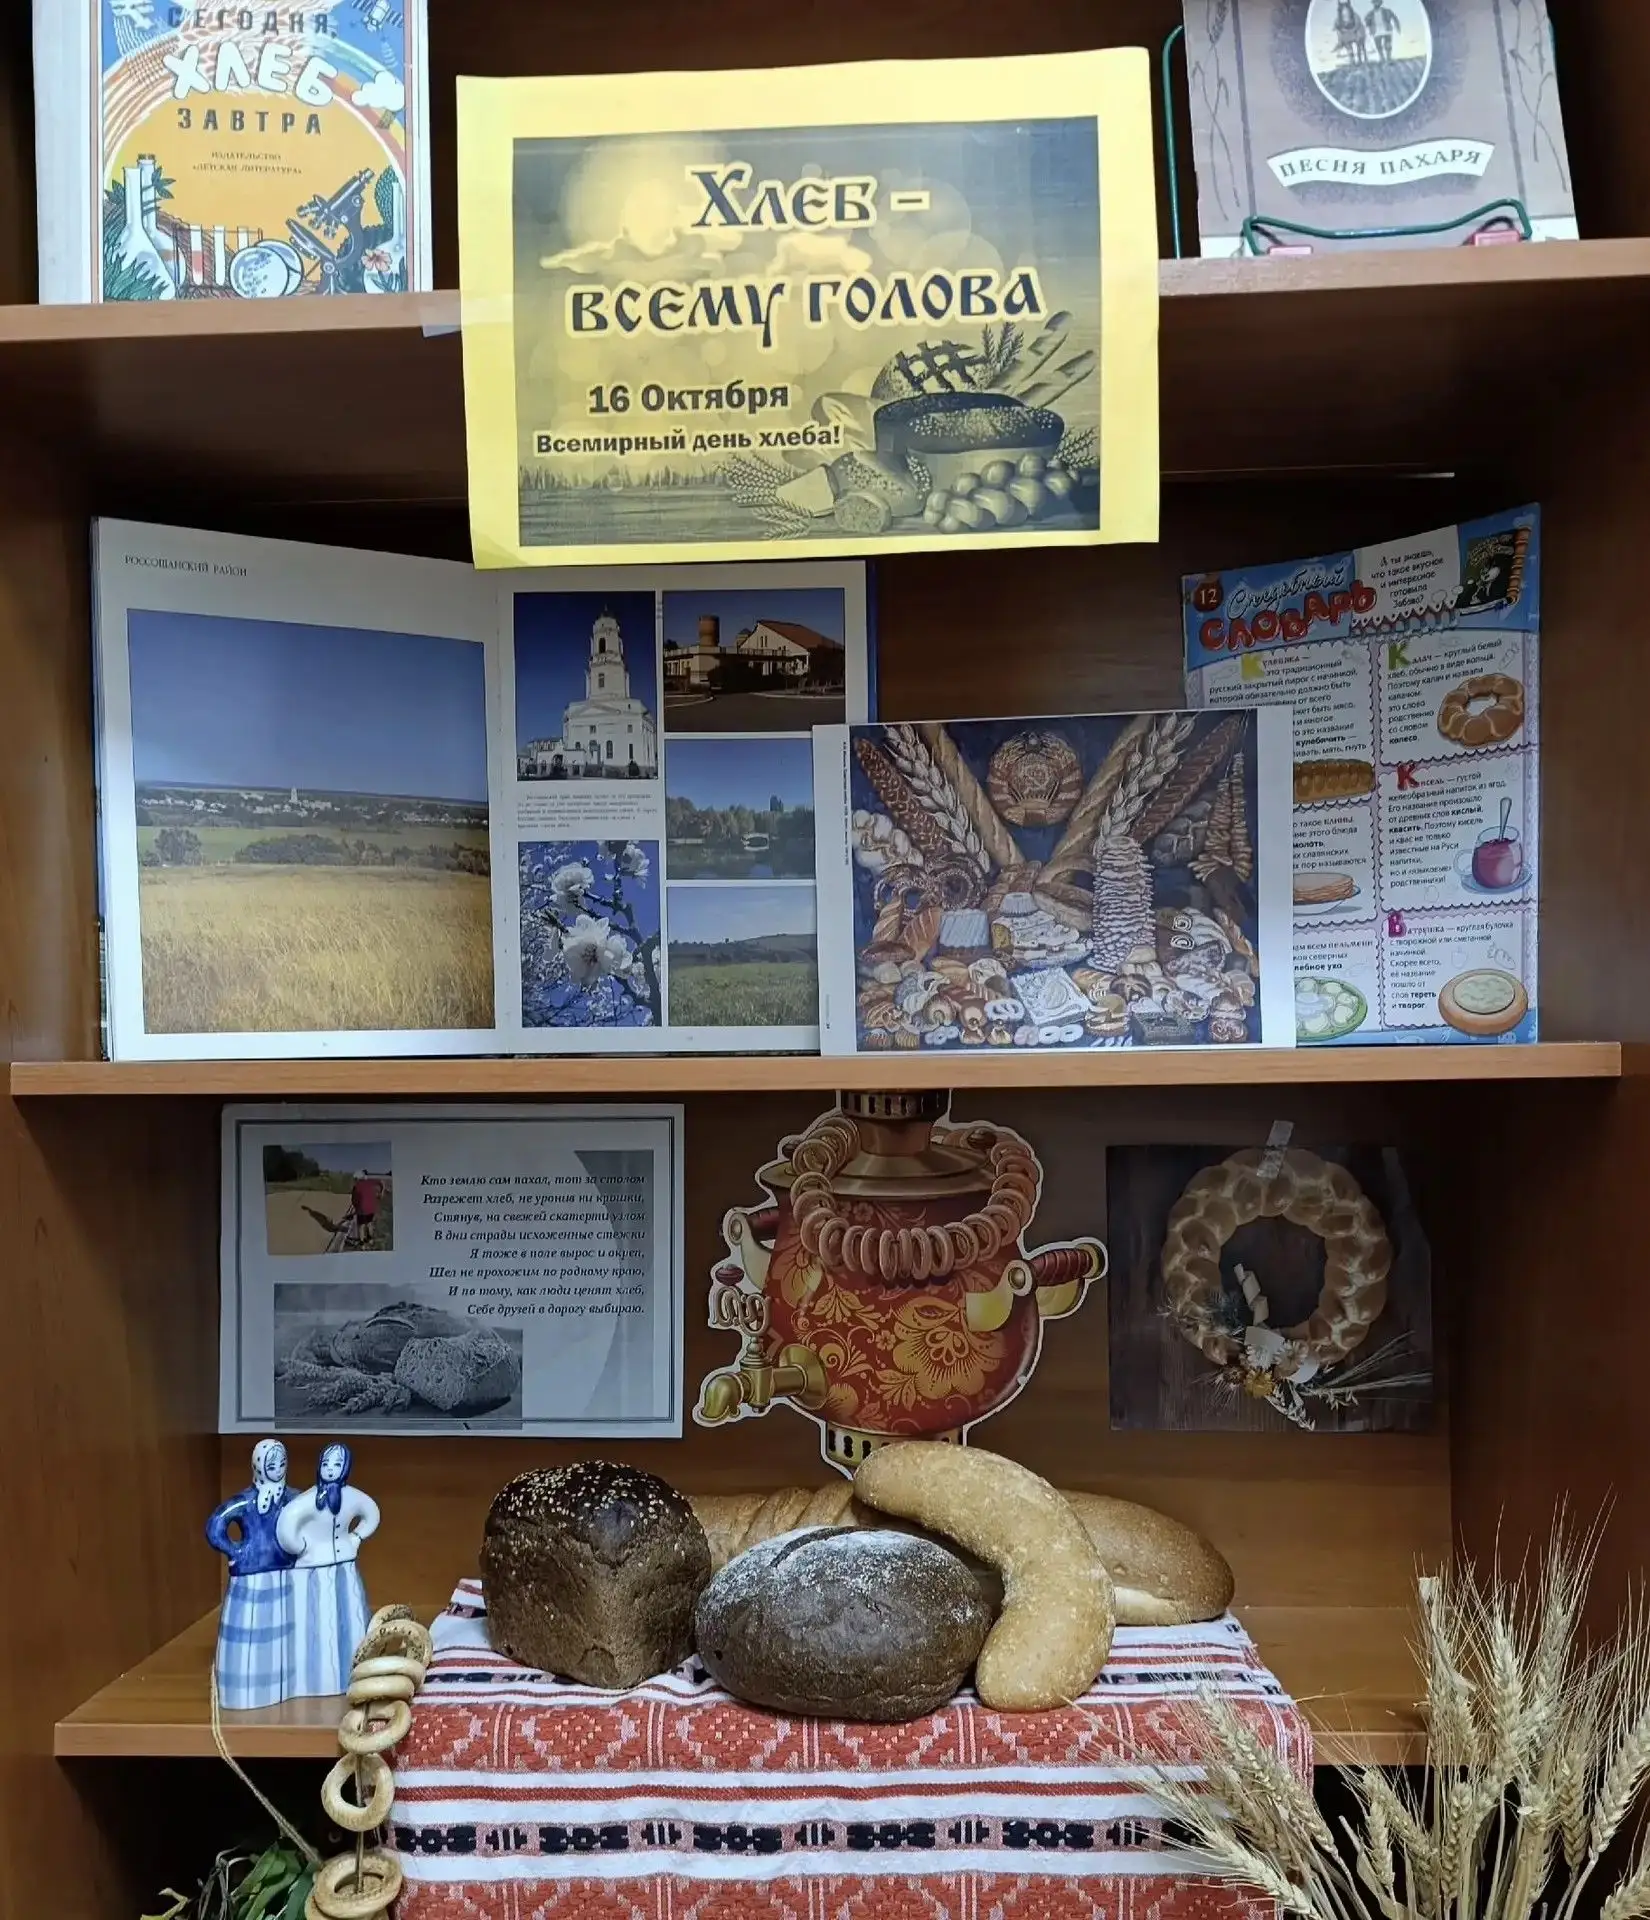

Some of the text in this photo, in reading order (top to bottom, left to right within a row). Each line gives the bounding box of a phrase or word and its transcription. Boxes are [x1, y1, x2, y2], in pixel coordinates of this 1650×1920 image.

[163, 40, 339, 107] ХЛЕБ
[177, 107, 322, 136] ЗАВТРА
[1279, 148, 1483, 178] ПЕСНЯ ПАХАРЯ
[588, 380, 789, 414] 16 Октября
[535, 425, 840, 455] Всемирный день хлеба!
[125, 555, 246, 576] РОССОШАНСКИЙ РАЙОН
[1200, 588, 1217, 604] 12
[420, 1175, 645, 1186] Кто землю сам пахал, тот за столом
[423, 1193, 645, 1205] Разрежет хлеб, не уронив ни крошки,
[433, 1211, 645, 1224] Стянув, на свежей скатерти узлом
[434, 1230, 645, 1242] В дни страды исхоженные стежки
[470, 1249, 645, 1260] Я тоже в поле вырос и окреп,
[429, 1267, 645, 1279] Шел не прохожим по родному краю,
[448, 1286, 645, 1298] И по тому, как люди ценят хлеб,
[467, 1304, 645, 1317] Себе друзей в дорогу выбираю.
